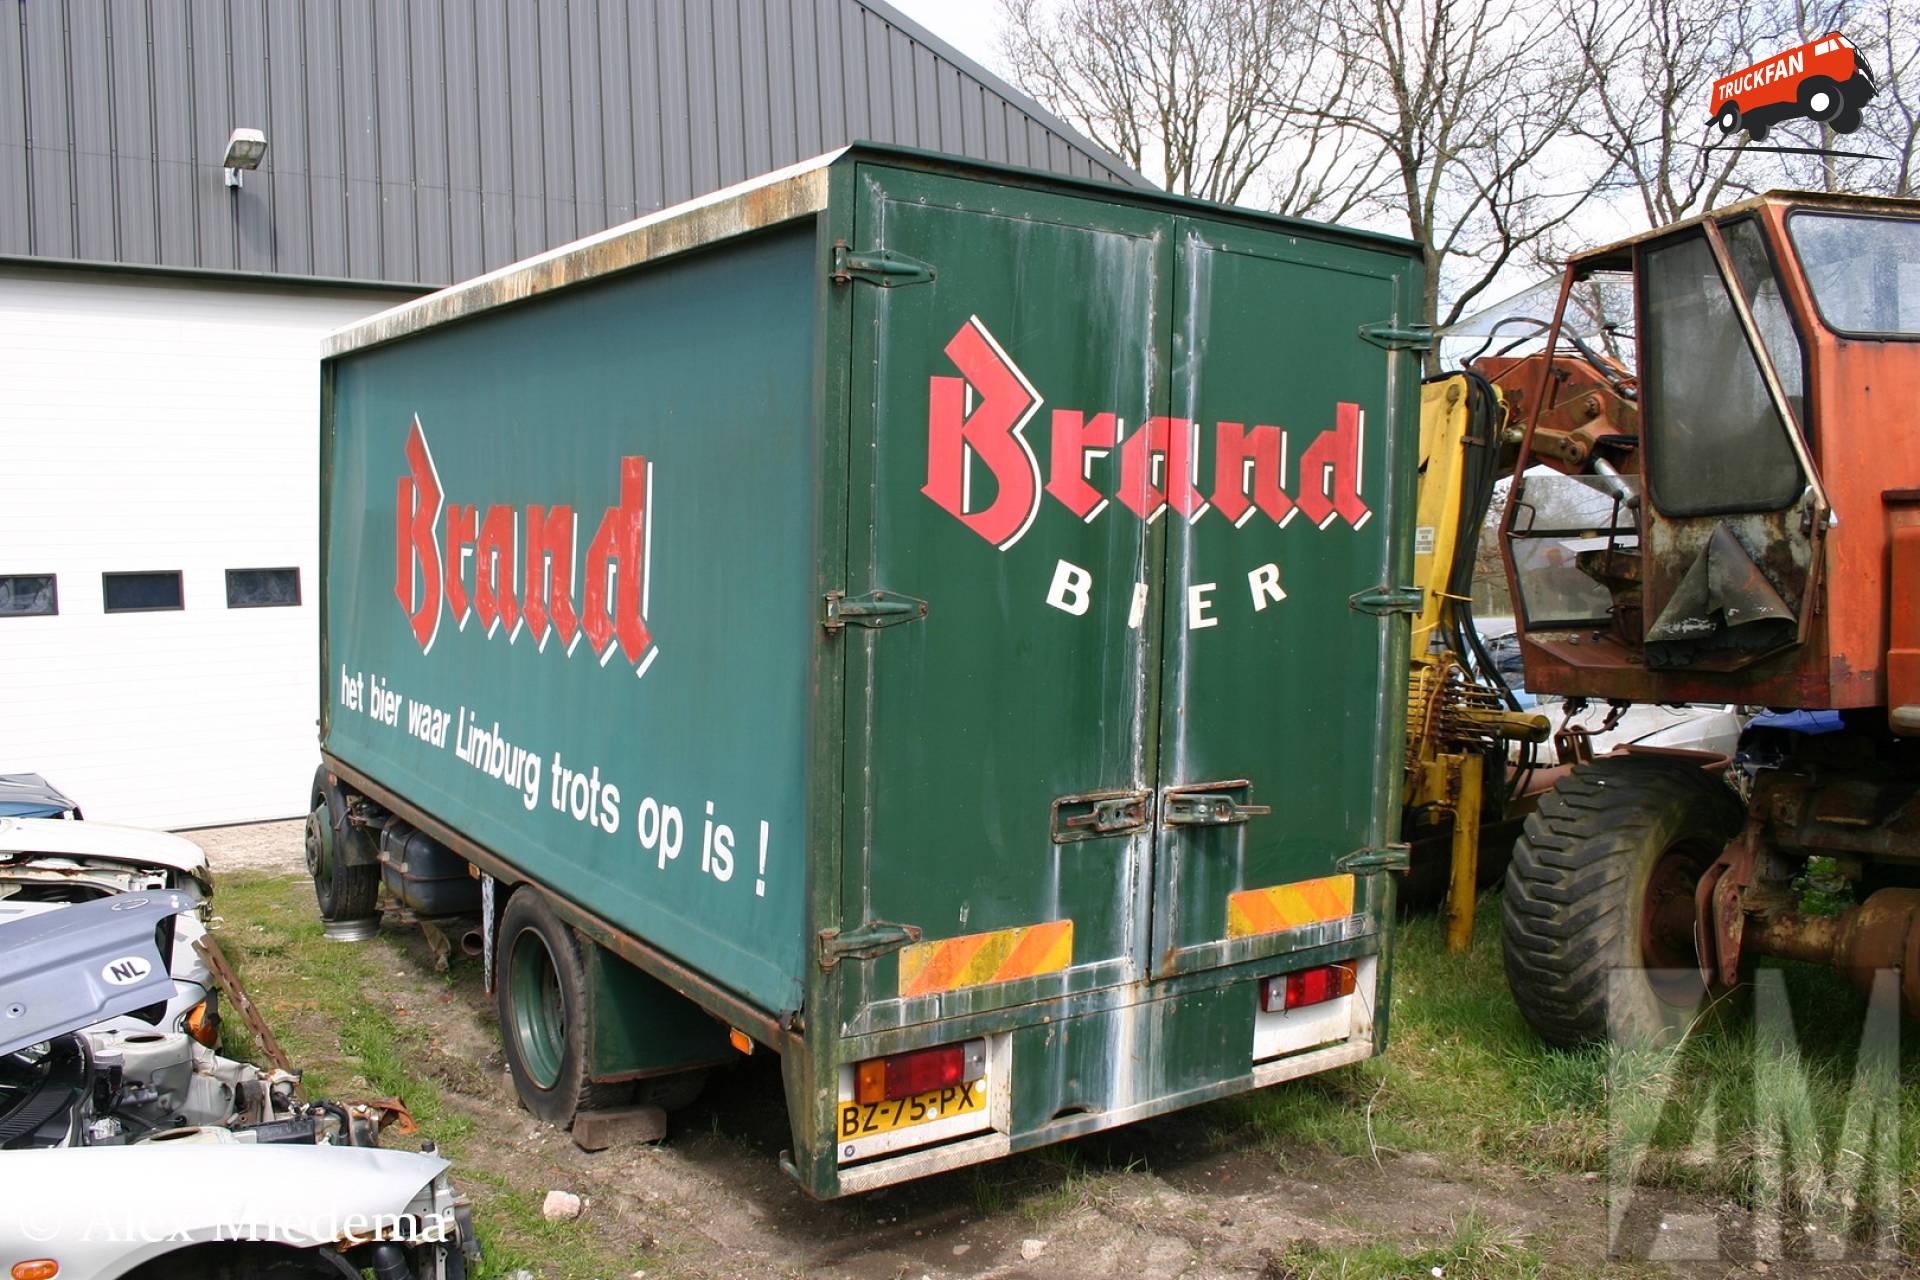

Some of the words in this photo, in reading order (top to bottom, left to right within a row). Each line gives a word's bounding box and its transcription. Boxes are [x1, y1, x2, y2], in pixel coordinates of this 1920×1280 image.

[920, 314, 1373, 551] Brand
[394, 411, 659, 679] Brand
[1045, 558, 1288, 631] BIER
[340, 663, 365, 713] het
[369, 673, 403, 728] bier
[408, 698, 451, 749] waar
[455, 705, 542, 811] Limburg
[551, 751, 621, 834] trots
[637, 796, 684, 870] op
[701, 800, 736, 882] is
[109, 960, 147, 982] NL
[841, 1082, 975, 1137] BZ-75-PX
